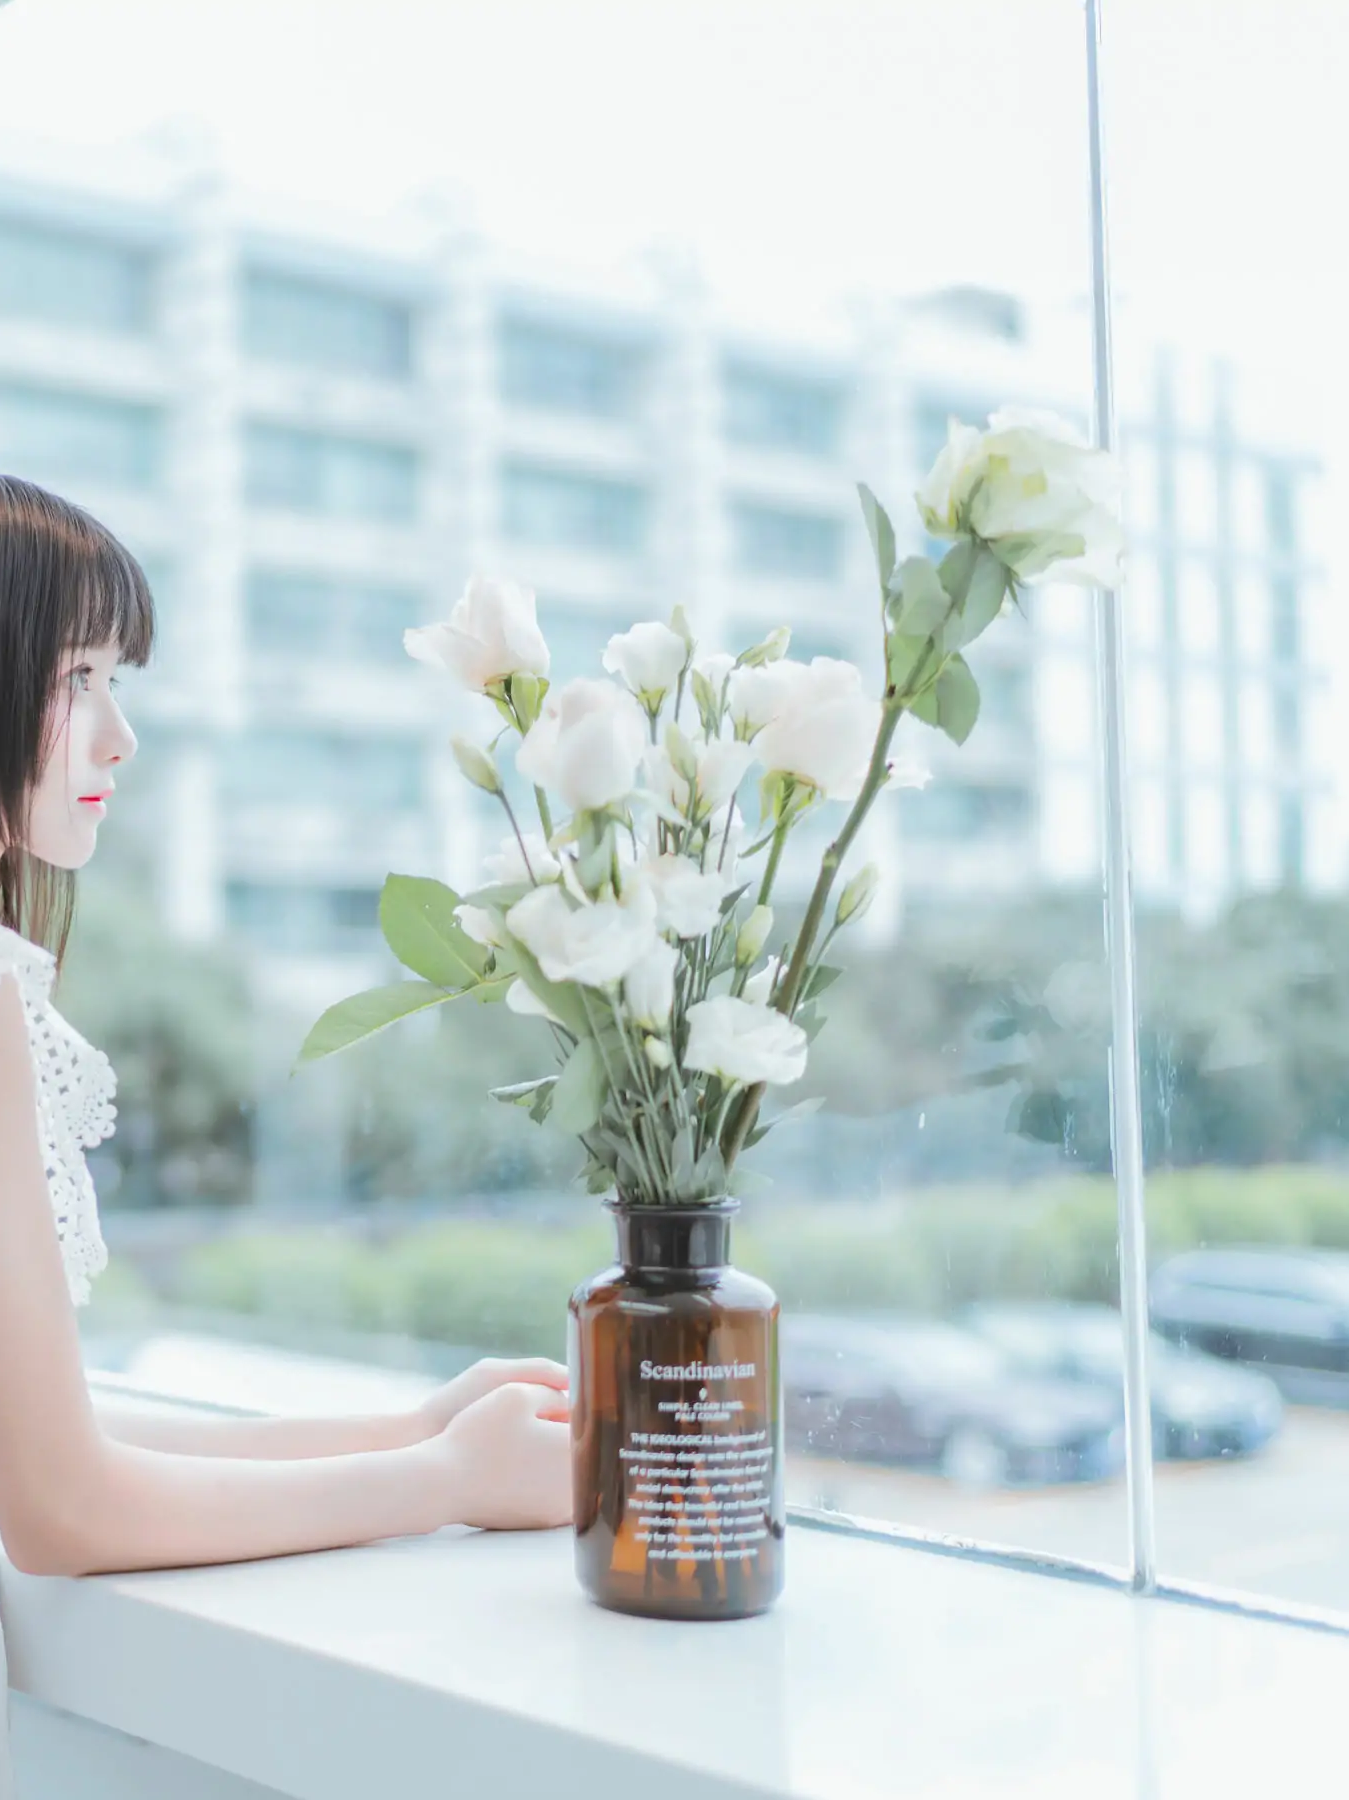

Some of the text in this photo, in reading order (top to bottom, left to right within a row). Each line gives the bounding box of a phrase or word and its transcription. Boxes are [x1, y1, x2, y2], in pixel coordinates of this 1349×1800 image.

[640, 1358, 756, 1381] Scandinavian
[630, 1432, 649, 1445] THE
[650, 1433, 712, 1446] IDEOLOGICAL
